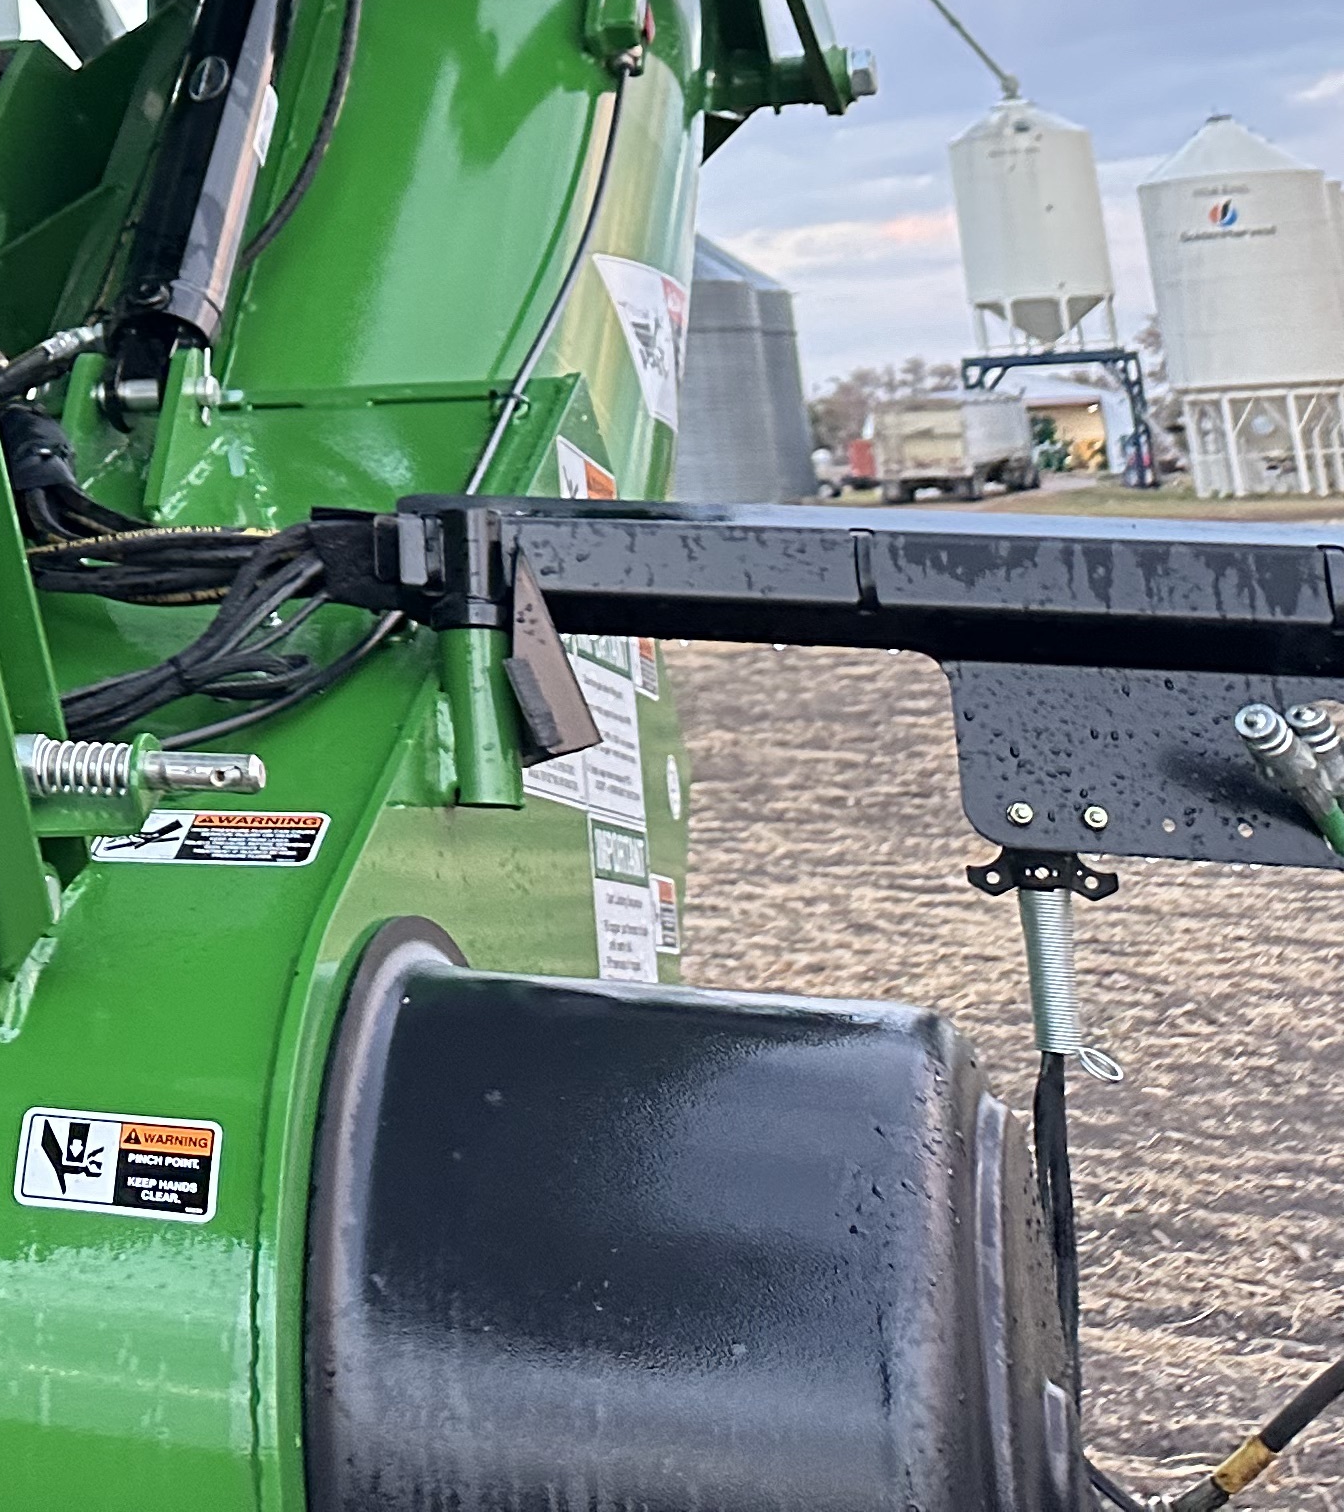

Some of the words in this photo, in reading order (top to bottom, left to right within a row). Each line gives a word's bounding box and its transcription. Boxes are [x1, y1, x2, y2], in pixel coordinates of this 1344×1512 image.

[218, 816, 318, 826] WARNING
[143, 1132, 209, 1149] WARNING
[127, 1152, 164, 1166] PINCH
[127, 1176, 158, 1189] KEEP
[158, 1179, 198, 1194] HANDS
[140, 1189, 182, 1204] CLEAR.
